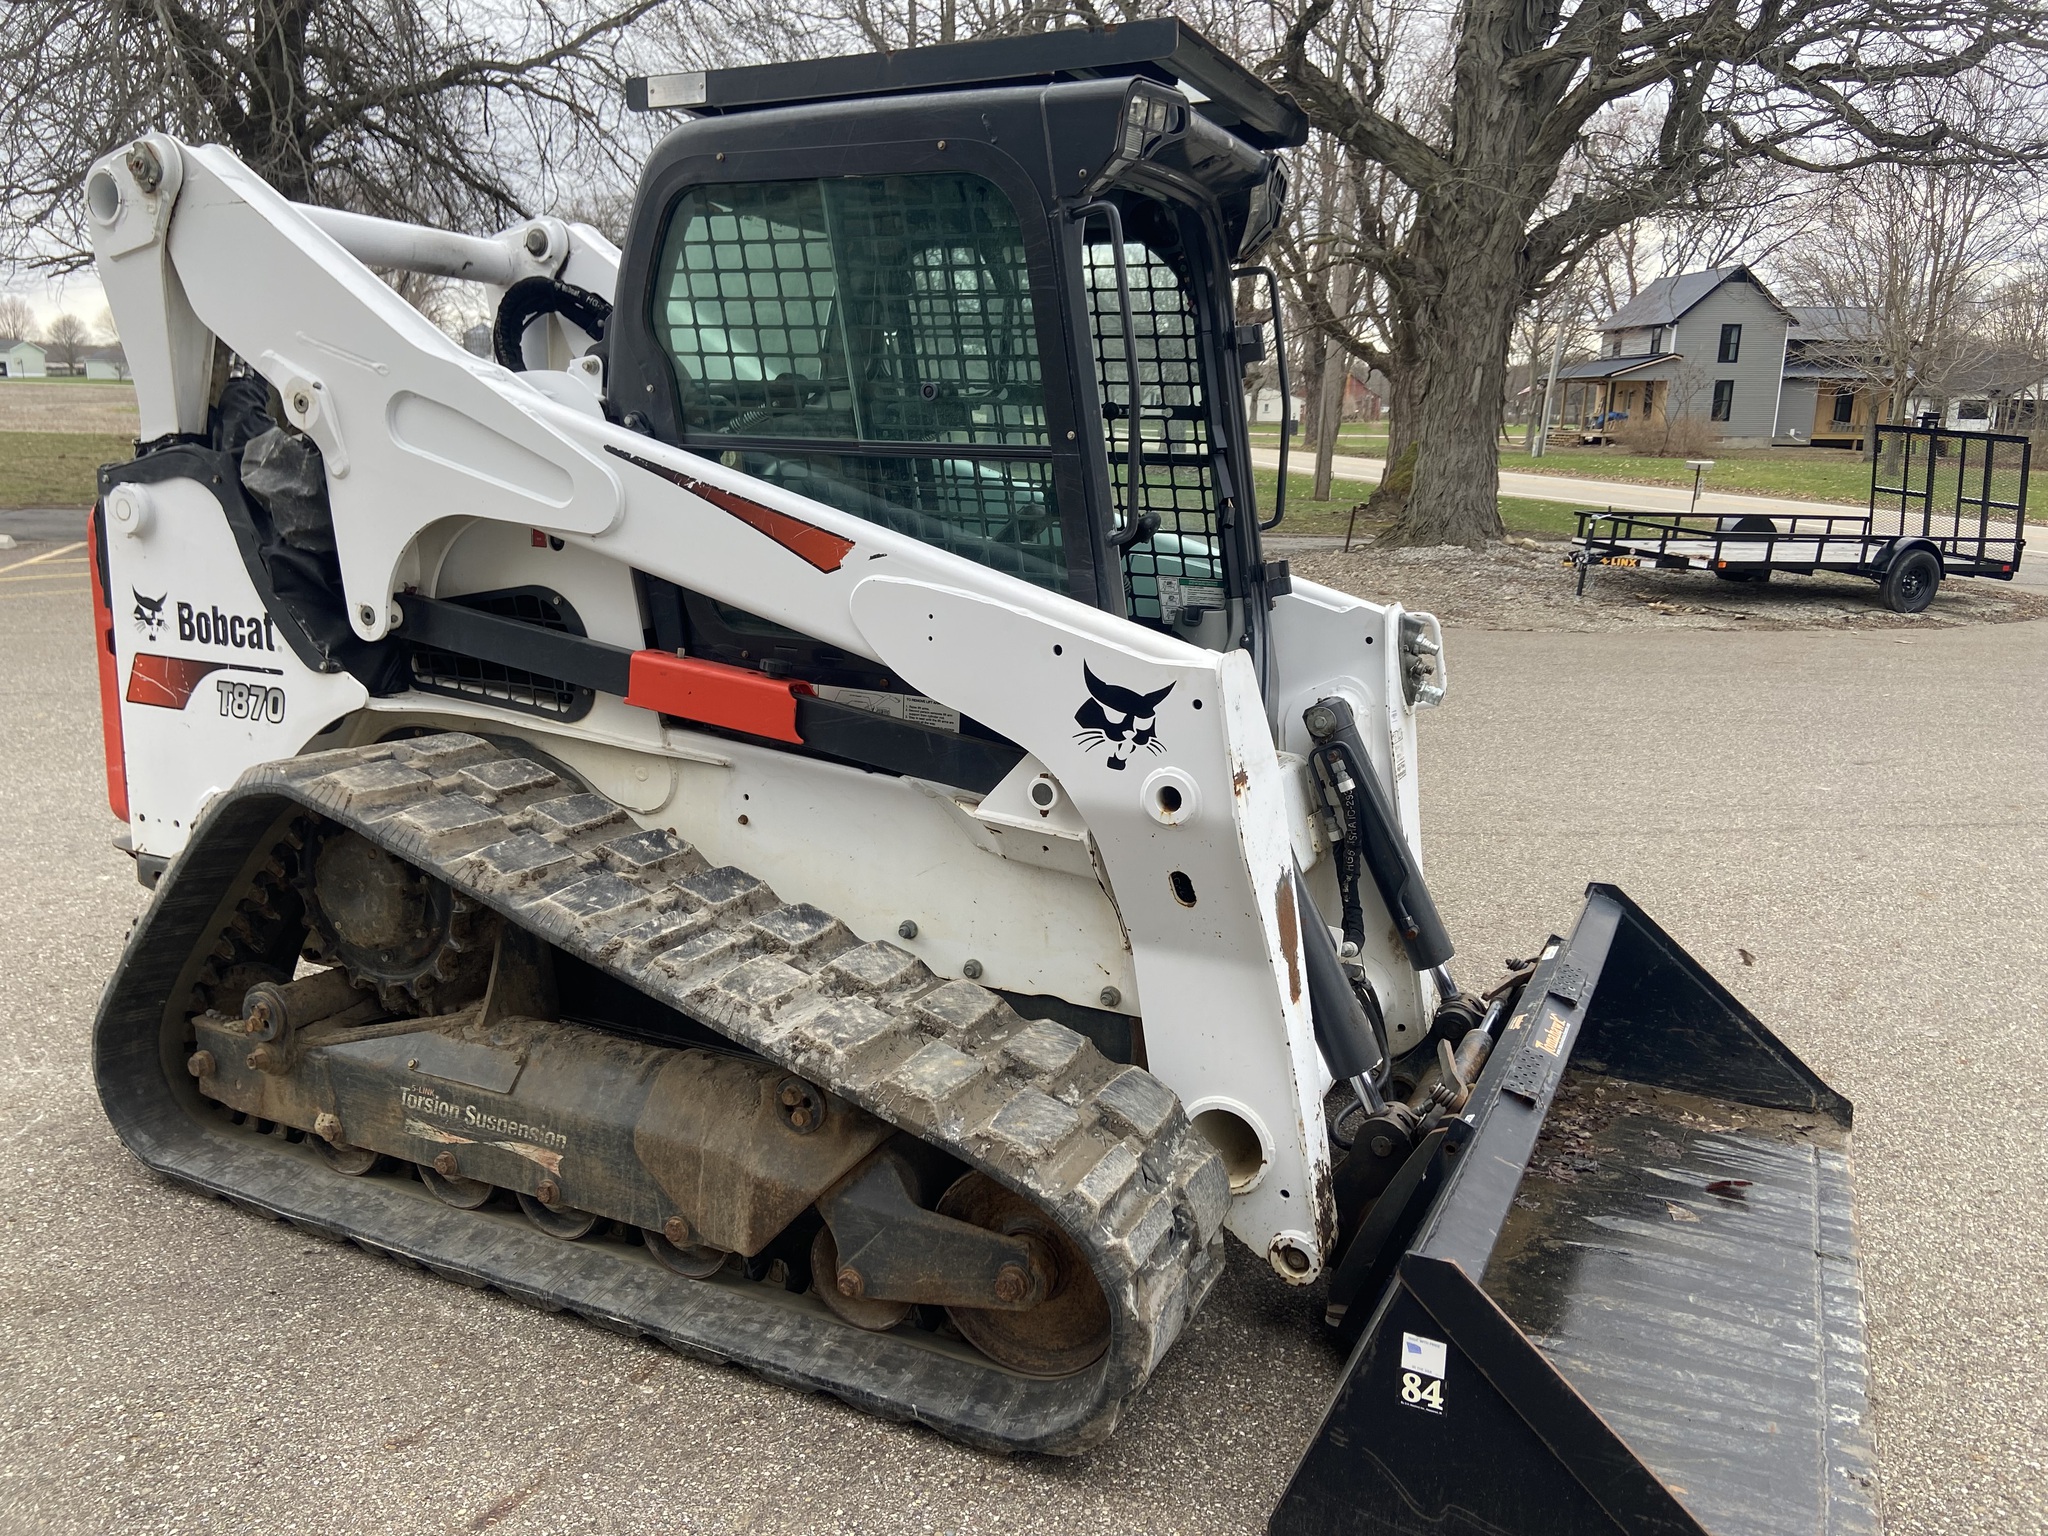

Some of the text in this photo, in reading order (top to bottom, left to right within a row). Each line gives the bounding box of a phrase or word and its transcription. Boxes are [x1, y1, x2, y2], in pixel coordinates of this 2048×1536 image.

[1611, 558, 1636, 567] LINX
[177, 602, 275, 651] Bobcat
[217, 680, 285, 724] T870
[400, 1086, 567, 1149] Torsion Suspension
[1401, 1372, 1444, 1411] 84
